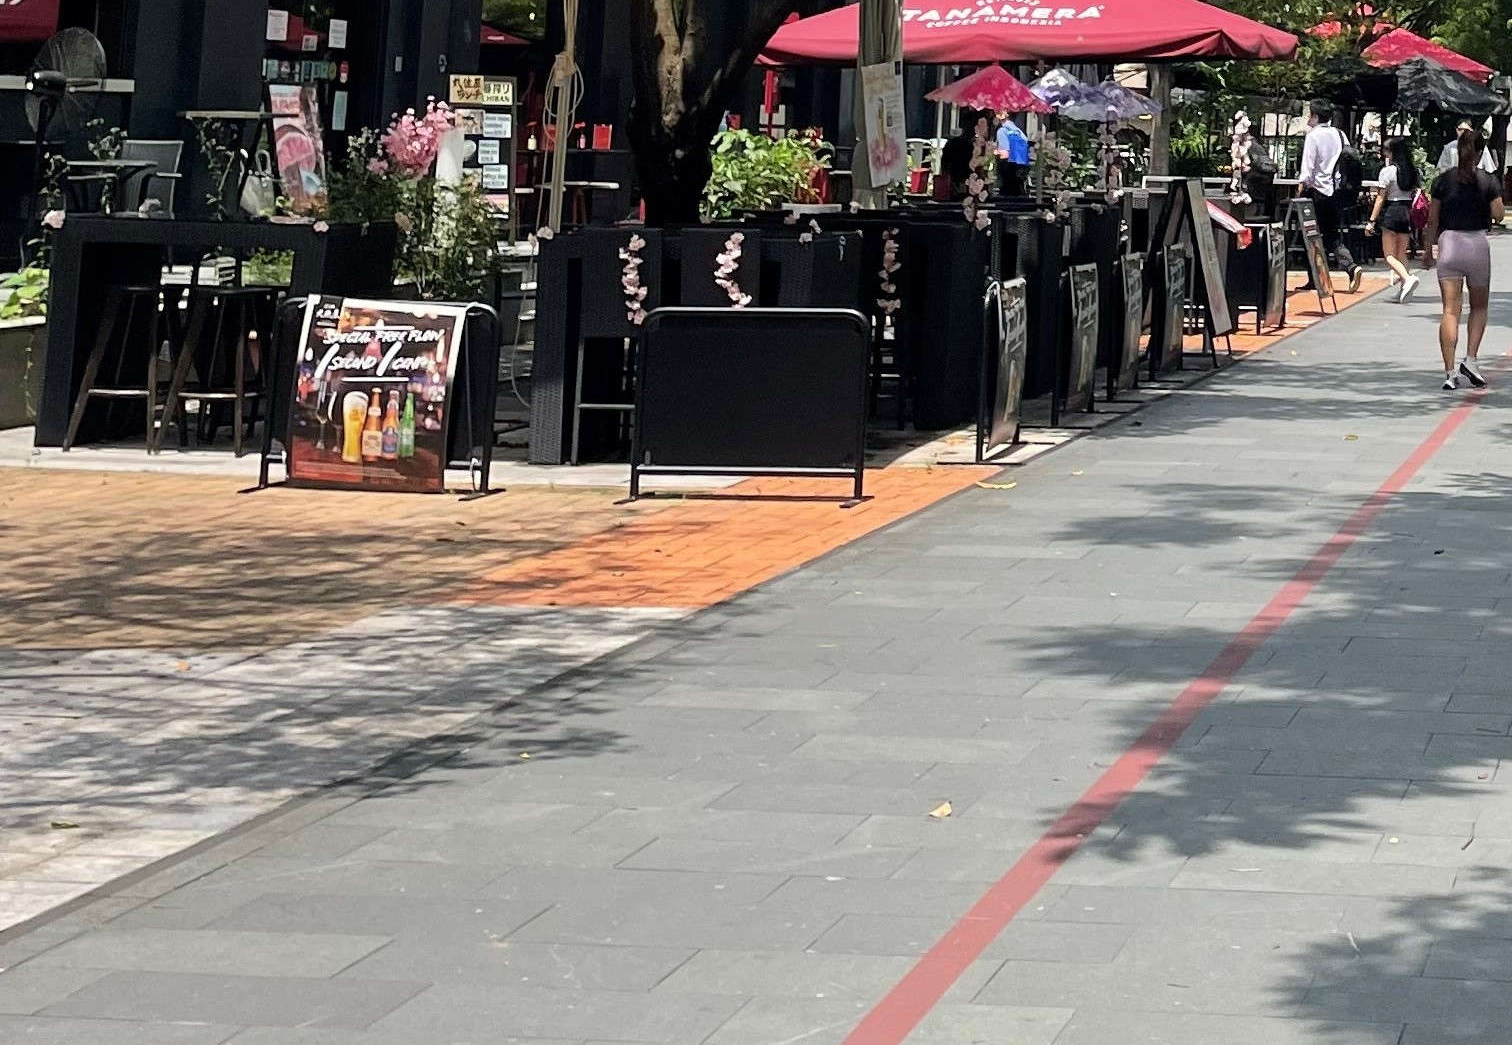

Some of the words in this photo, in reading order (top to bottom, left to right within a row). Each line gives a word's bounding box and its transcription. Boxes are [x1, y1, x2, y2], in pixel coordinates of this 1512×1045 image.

[902, 5, 1101, 22] TANAMERA
[984, 15, 1062, 26] INDONESIA
[322, 329, 371, 344] SPECIAL
[375, 330, 408, 342] FREE
[408, 328, 445, 342] FLOW
[329, 356, 377, 370] SECOND
